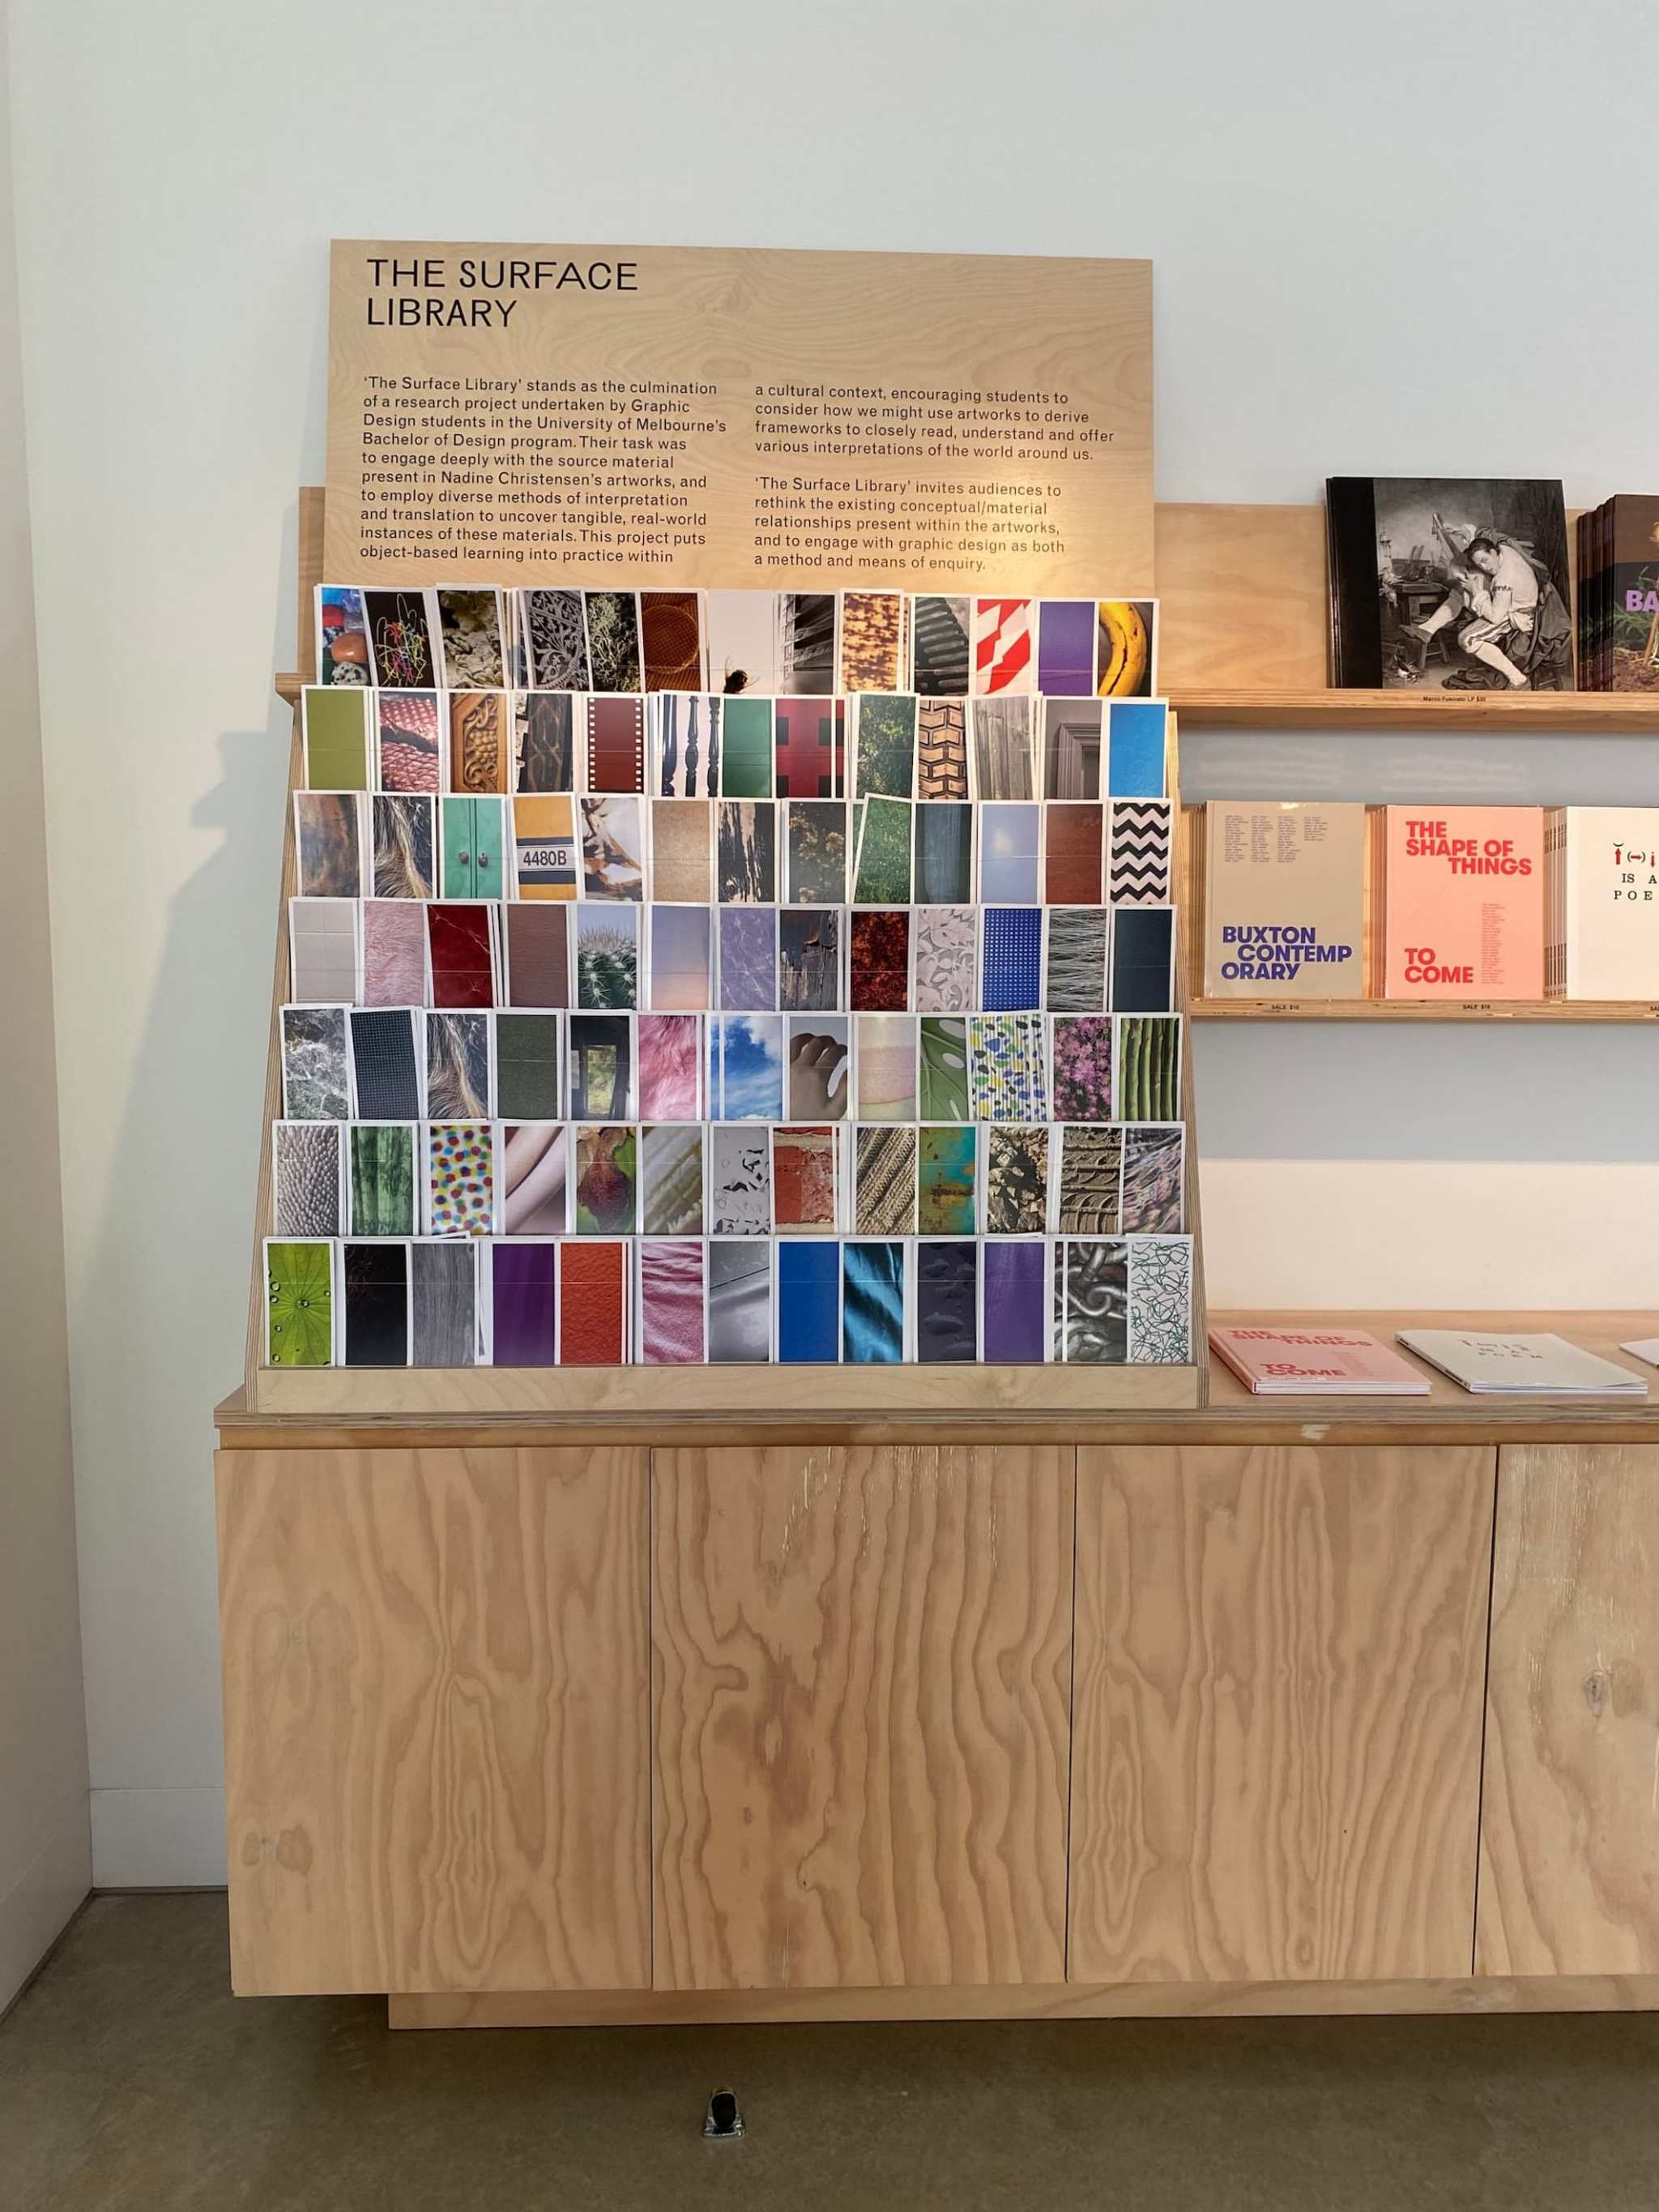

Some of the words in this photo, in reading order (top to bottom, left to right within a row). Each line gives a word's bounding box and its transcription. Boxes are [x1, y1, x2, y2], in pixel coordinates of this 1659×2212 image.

[367, 259, 446, 288] THE
[459, 260, 638, 290] SURFACE
[367, 297, 517, 327] LIBRARY
[364, 376, 397, 389] 'The
[402, 376, 460, 391] Surface
[466, 378, 522, 394] Library'
[527, 379, 576, 392] stands
[581, 382, 598, 393] as
[602, 380, 625, 393] the
[629, 381, 717, 395] culmination
[755, 386, 766, 395] a
[768, 383, 824, 397] cultural
[829, 386, 886, 400] context,
[891, 389, 981, 404] encouraging
[986, 390, 1049, 404] students
[1053, 392, 1068, 404] to
[364, 394, 377, 408] of
[382, 398, 390, 408] a
[395, 395, 459, 409] research
[464, 397, 517, 412] project
[522, 397, 604, 412] undertaken
[610, 399, 628, 415] by
[631, 399, 689, 415] Graphic
[755, 402, 819, 416] consider
[823, 403, 852, 416] how
[857, 408, 877, 417] we
[882, 404, 925, 421] might
[927, 409, 953, 423] use
[957, 408, 1021, 421] artworks
[1025, 410, 1039, 421] to
[1044, 409, 1089, 423] derive
[364, 413, 416, 429] Design
[421, 415, 486, 429] students
[491, 415, 504, 428] in
[509, 416, 532, 429] the
[537, 416, 613, 433] University
[617, 417, 632, 430] of
[637, 417, 726, 432] Melbourne's
[755, 420, 842, 435] frameworks
[846, 423, 864, 436] to
[865, 423, 916, 440] closely
[921, 425, 957, 441] read,
[962, 425, 1043, 441] understand
[1048, 429, 1075, 442] and
[1080, 429, 1114, 442] offer
[363, 432, 430, 446] Bachelor
[434, 433, 449, 446] of
[453, 433, 505, 450] Design
[510, 438, 577, 451] program.
[578, 435, 618, 449] Their
[622, 436, 654, 450] task
[658, 440, 686, 451] was
[755, 438, 812, 453] various
[814, 441, 923, 457] interpretations
[928, 443, 942, 456] of
[945, 443, 969, 457] the
[973, 445, 1013, 459] world
[1017, 446, 1068, 459] around
[1073, 450, 1093, 460] us.
[361, 452, 377, 463] to
[381, 454, 436, 468] engage
[440, 451, 489, 468] deeply
[492, 453, 525, 467] with
[530, 452, 553, 467] the
[558, 457, 608, 468] source
[612, 455, 673, 468] material
[362, 472, 419, 485] present
[423, 471, 436, 484] in
[441, 470, 493, 485] Nadine
[498, 471, 602, 486] Christensen's
[607, 474, 676, 489] artworks,
[680, 475, 706, 488] and
[755, 476, 787, 490] 'The
[792, 476, 851, 491] Surface
[855, 478, 911, 495] Library'
[916, 480, 964, 494] invites
[968, 483, 1043, 496] audiences
[1047, 485, 1061, 497] to
[360, 489, 378, 501] to
[380, 489, 434, 506] employ
[438, 489, 493, 503] diverse
[498, 490, 562, 504] methods
[566, 491, 582, 505] of
[585, 492, 688, 508] interpretation
[755, 495, 806, 510] rethink
[809, 496, 834, 512] the
[836, 497, 895, 514] existing
[900, 501, 1047, 515] conceptual/material
[360, 506, 387, 520] and
[392, 507, 475, 523] translation
[479, 510, 494, 522] to
[499, 512, 558, 523] uncover
[561, 510, 626, 527] tangible,
[631, 512, 706, 526] real-world
[755, 514, 851, 532] relationships
[856, 519, 913, 532] present
[915, 519, 960, 532] within
[965, 519, 987, 532] the
[992, 521, 1059, 536] artworks,
[360, 526, 433, 540] instances
[437, 527, 453, 540] of
[456, 527, 497, 540] these
[502, 528, 577, 542] materials.
[579, 529, 614, 543] This
[617, 531, 669, 546] project
[674, 532, 706, 547] puts
[755, 533, 781, 548] and
[785, 535, 800, 549] to
[804, 537, 859, 551] engage
[862, 535, 893, 549] with
[898, 536, 953, 553] graphic
[958, 538, 1006, 553] design
[1011, 543, 1027, 552] as
[1033, 539, 1064, 553] both
[360, 544, 458, 561] object-based
[463, 546, 524, 562] learning
[529, 547, 557, 561] into
[563, 549, 624, 564] practice
[628, 549, 673, 562] within
[754, 555, 763, 565] a
[767, 553, 822, 566] method
[827, 553, 853, 567] and
[859, 557, 906, 568] means
[911, 556, 925, 568] of
[929, 557, 985, 572] enquiry.
[1405, 821, 1447, 838] THE
[1406, 839, 1478, 856] SHAPE
[1484, 839, 1513, 856] OF
[523, 850, 567, 866] 4480B
[1448, 857, 1532, 876] THINGS
[1622, 873, 1635, 884] IS
[1648, 874, 1658, 884] A
[1222, 926, 1316, 944] BUXTON
[1238, 944, 1353, 963] CONTEMP
[1405, 948, 1435, 965] TO
[1222, 962, 1301, 980] ORARY
[1405, 966, 1473, 983] COME
